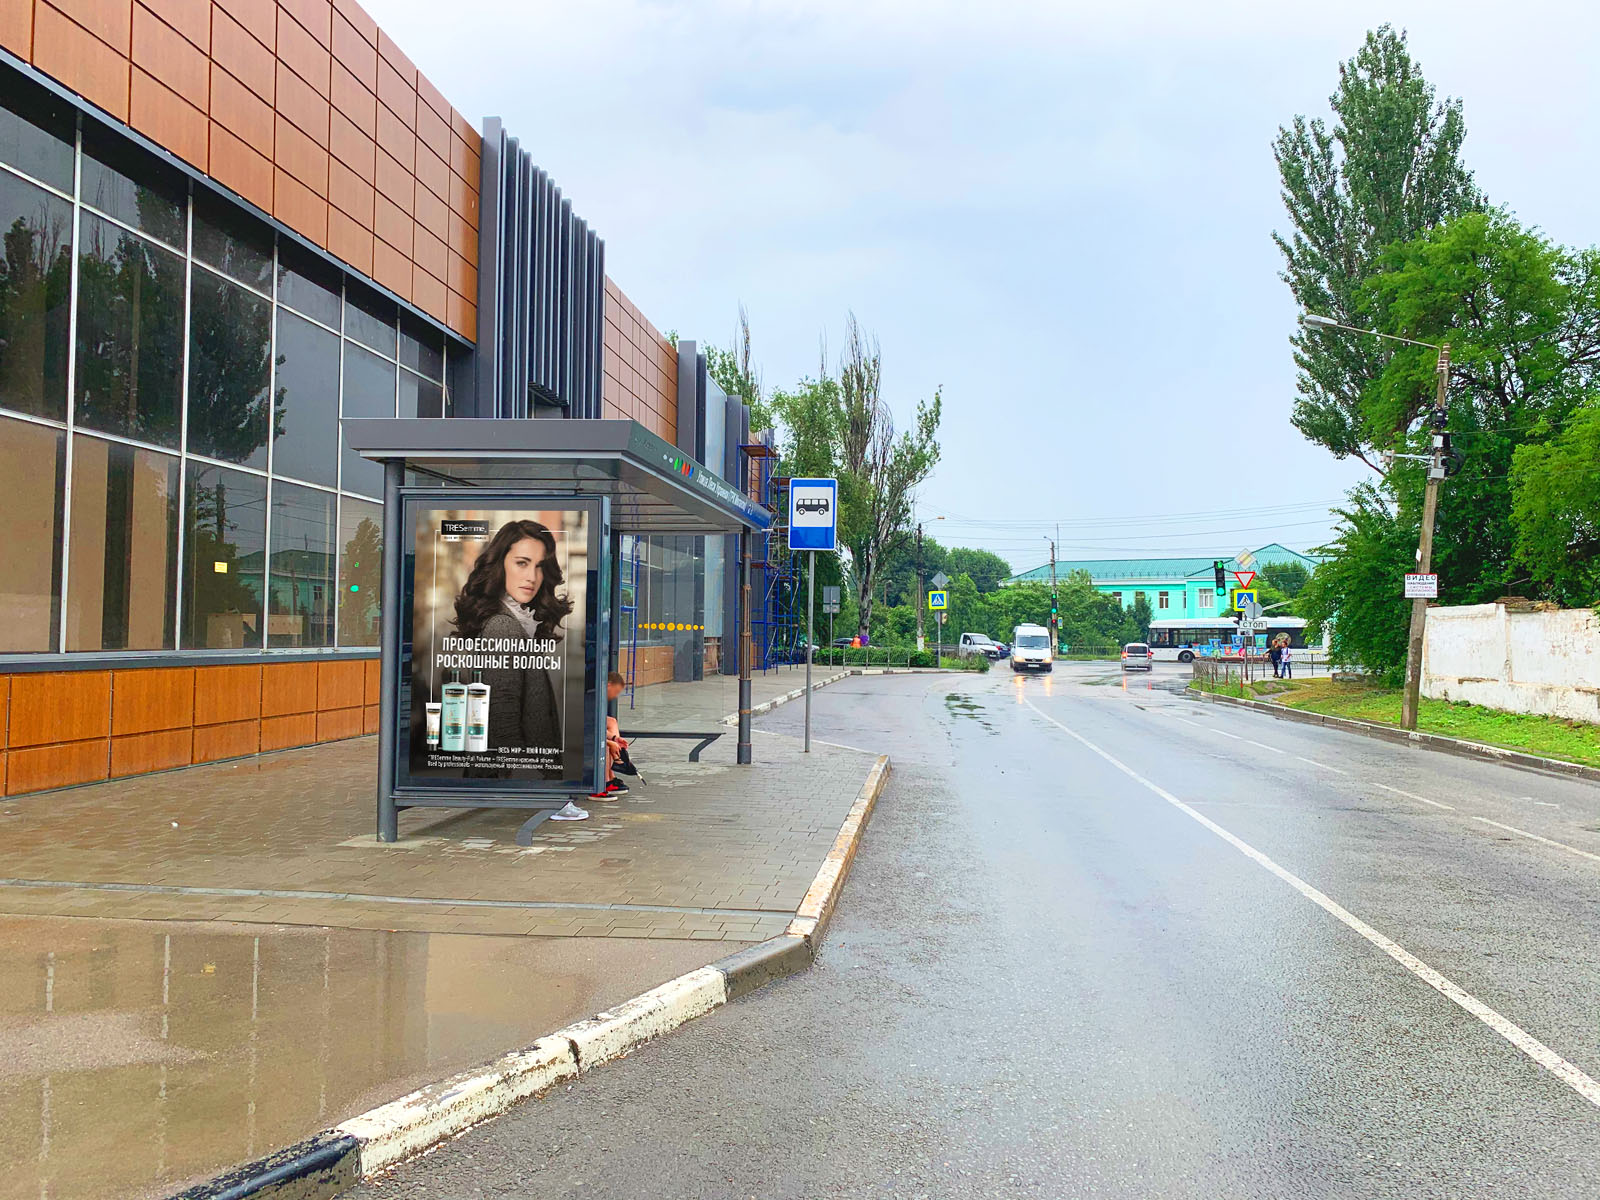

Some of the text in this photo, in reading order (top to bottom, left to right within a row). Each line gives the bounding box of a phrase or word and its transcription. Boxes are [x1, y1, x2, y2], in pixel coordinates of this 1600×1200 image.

[442, 637, 556, 653] ПРОФЕССИОНАЛЬНО
[436, 654, 561, 670] РОСКОШНЫЕ ВОЛОСЫ
